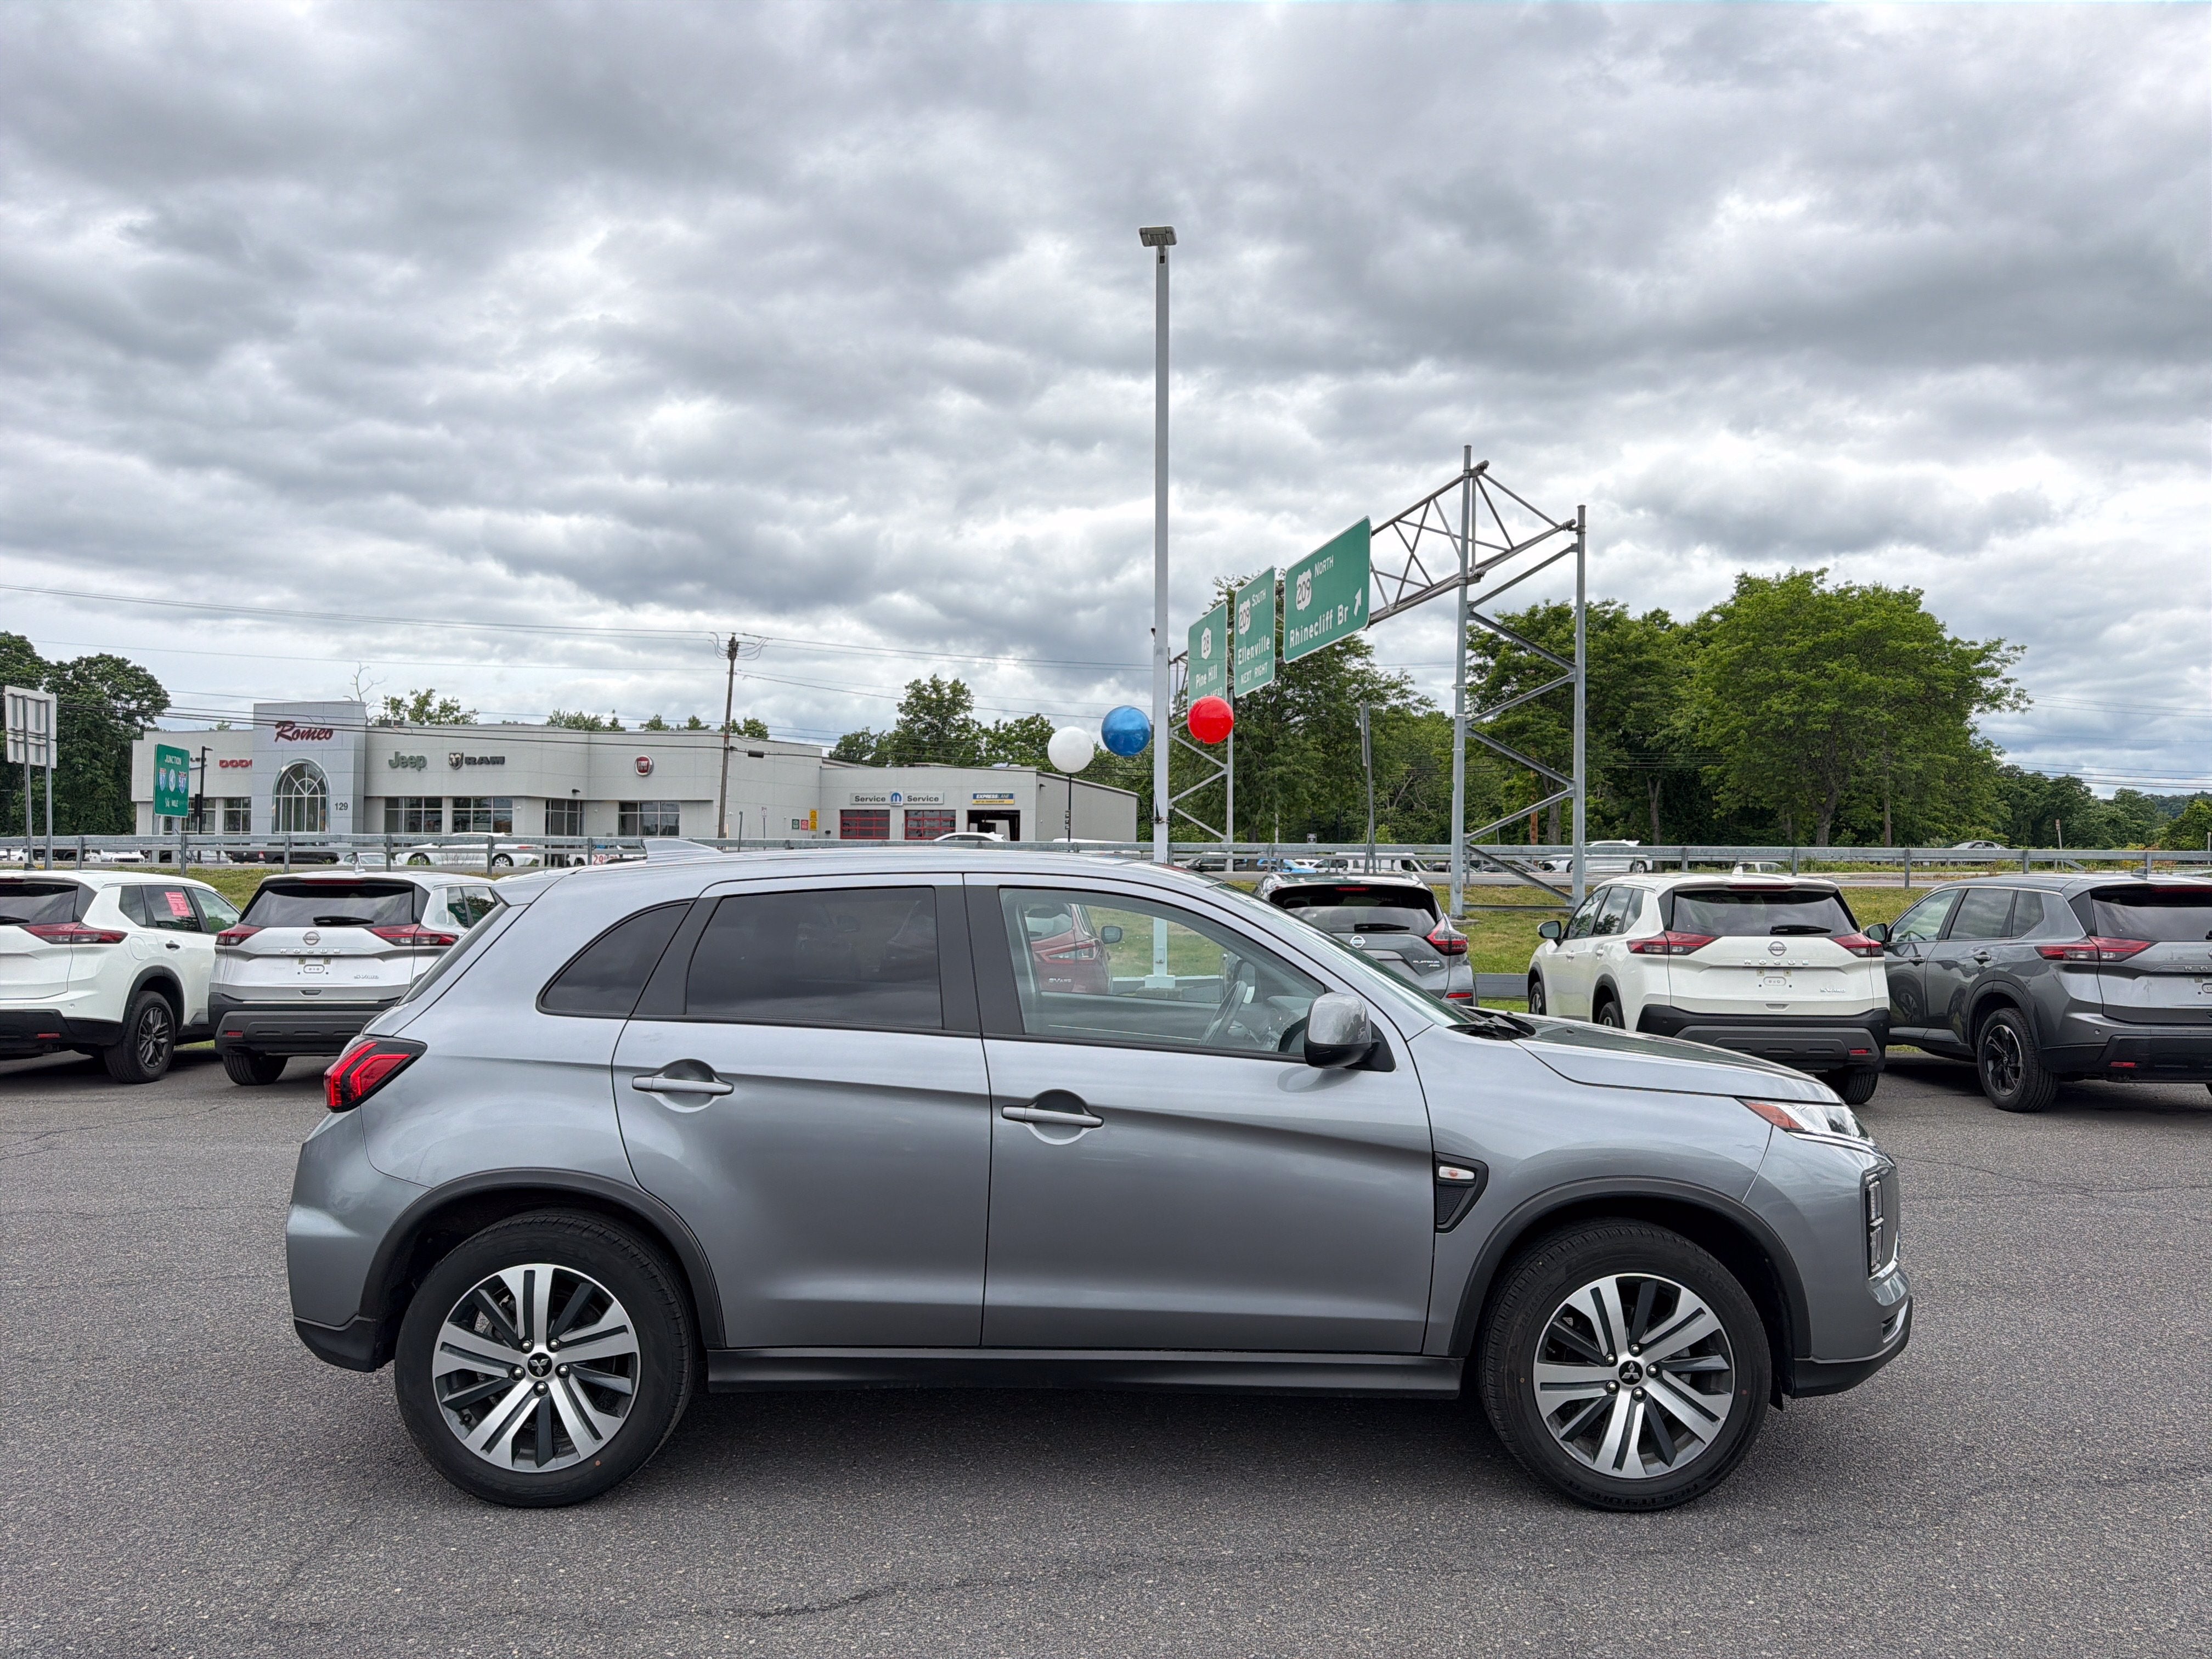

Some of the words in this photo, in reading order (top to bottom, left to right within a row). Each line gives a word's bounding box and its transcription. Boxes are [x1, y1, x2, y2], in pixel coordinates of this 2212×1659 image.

[1314, 555, 1334, 578] NORTH
[1252, 589, 1266, 607] SOUTH
[1297, 578, 1311, 605] 209
[1239, 607, 1250, 630] 209
[1290, 608, 1333, 648] Rhinecliff
[1338, 604, 1348, 625] Br
[1203, 635, 1210, 653] 28
[1238, 635, 1270, 665] Ellenville
[1196, 673, 1207, 689] Pine
[1208, 664, 1217, 682] Hill
[1240, 670, 1252, 685] NEXT
[1254, 662, 1268, 679] RIGHT
[275, 721, 334, 742] Romeo
[165, 754, 182, 765] JUNCTION
[388, 751, 427, 771] Jeep
[465, 756, 505, 765] RAM
[335, 802, 348, 811] 129
